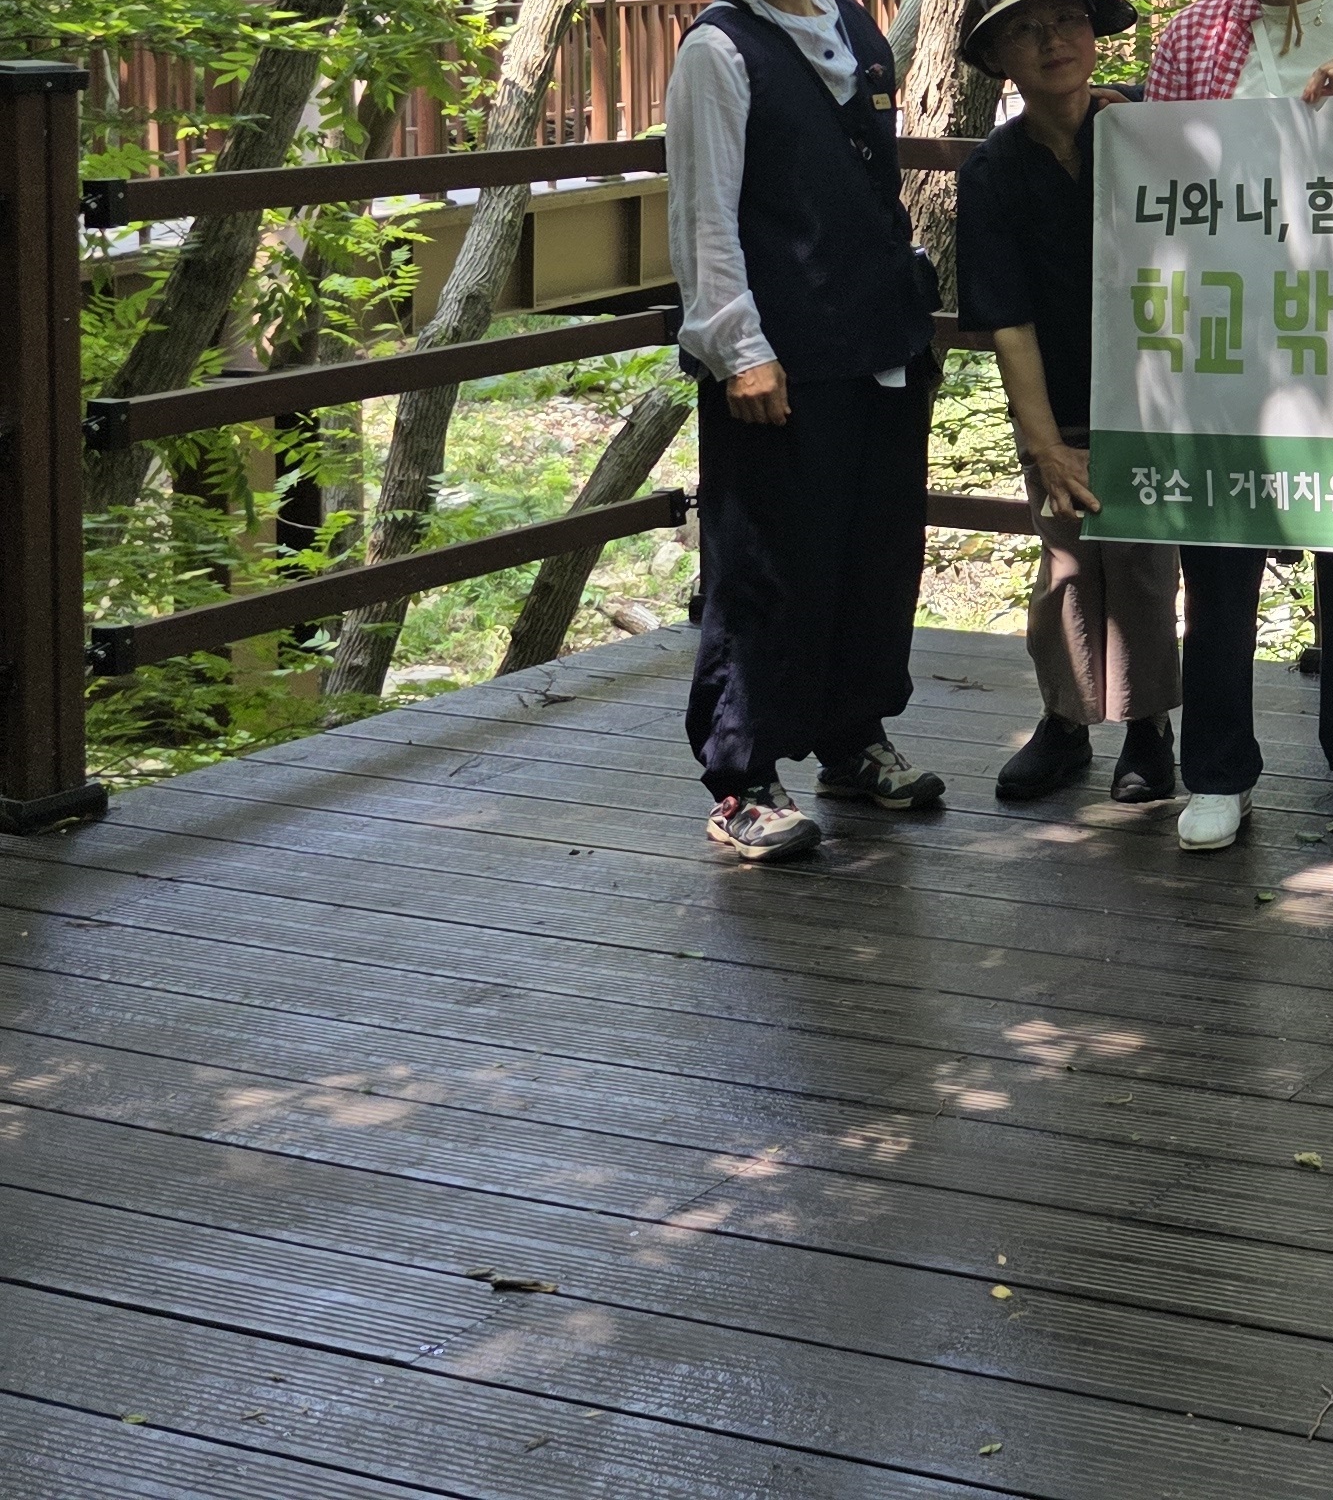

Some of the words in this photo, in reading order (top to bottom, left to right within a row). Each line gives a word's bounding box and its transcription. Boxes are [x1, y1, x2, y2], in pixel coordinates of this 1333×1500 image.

[1135, 178, 1223, 236] 너와
[1236, 177, 1289, 242] 나,
[1132, 268, 1244, 375] 학교
[1131, 466, 1193, 506] 장소
